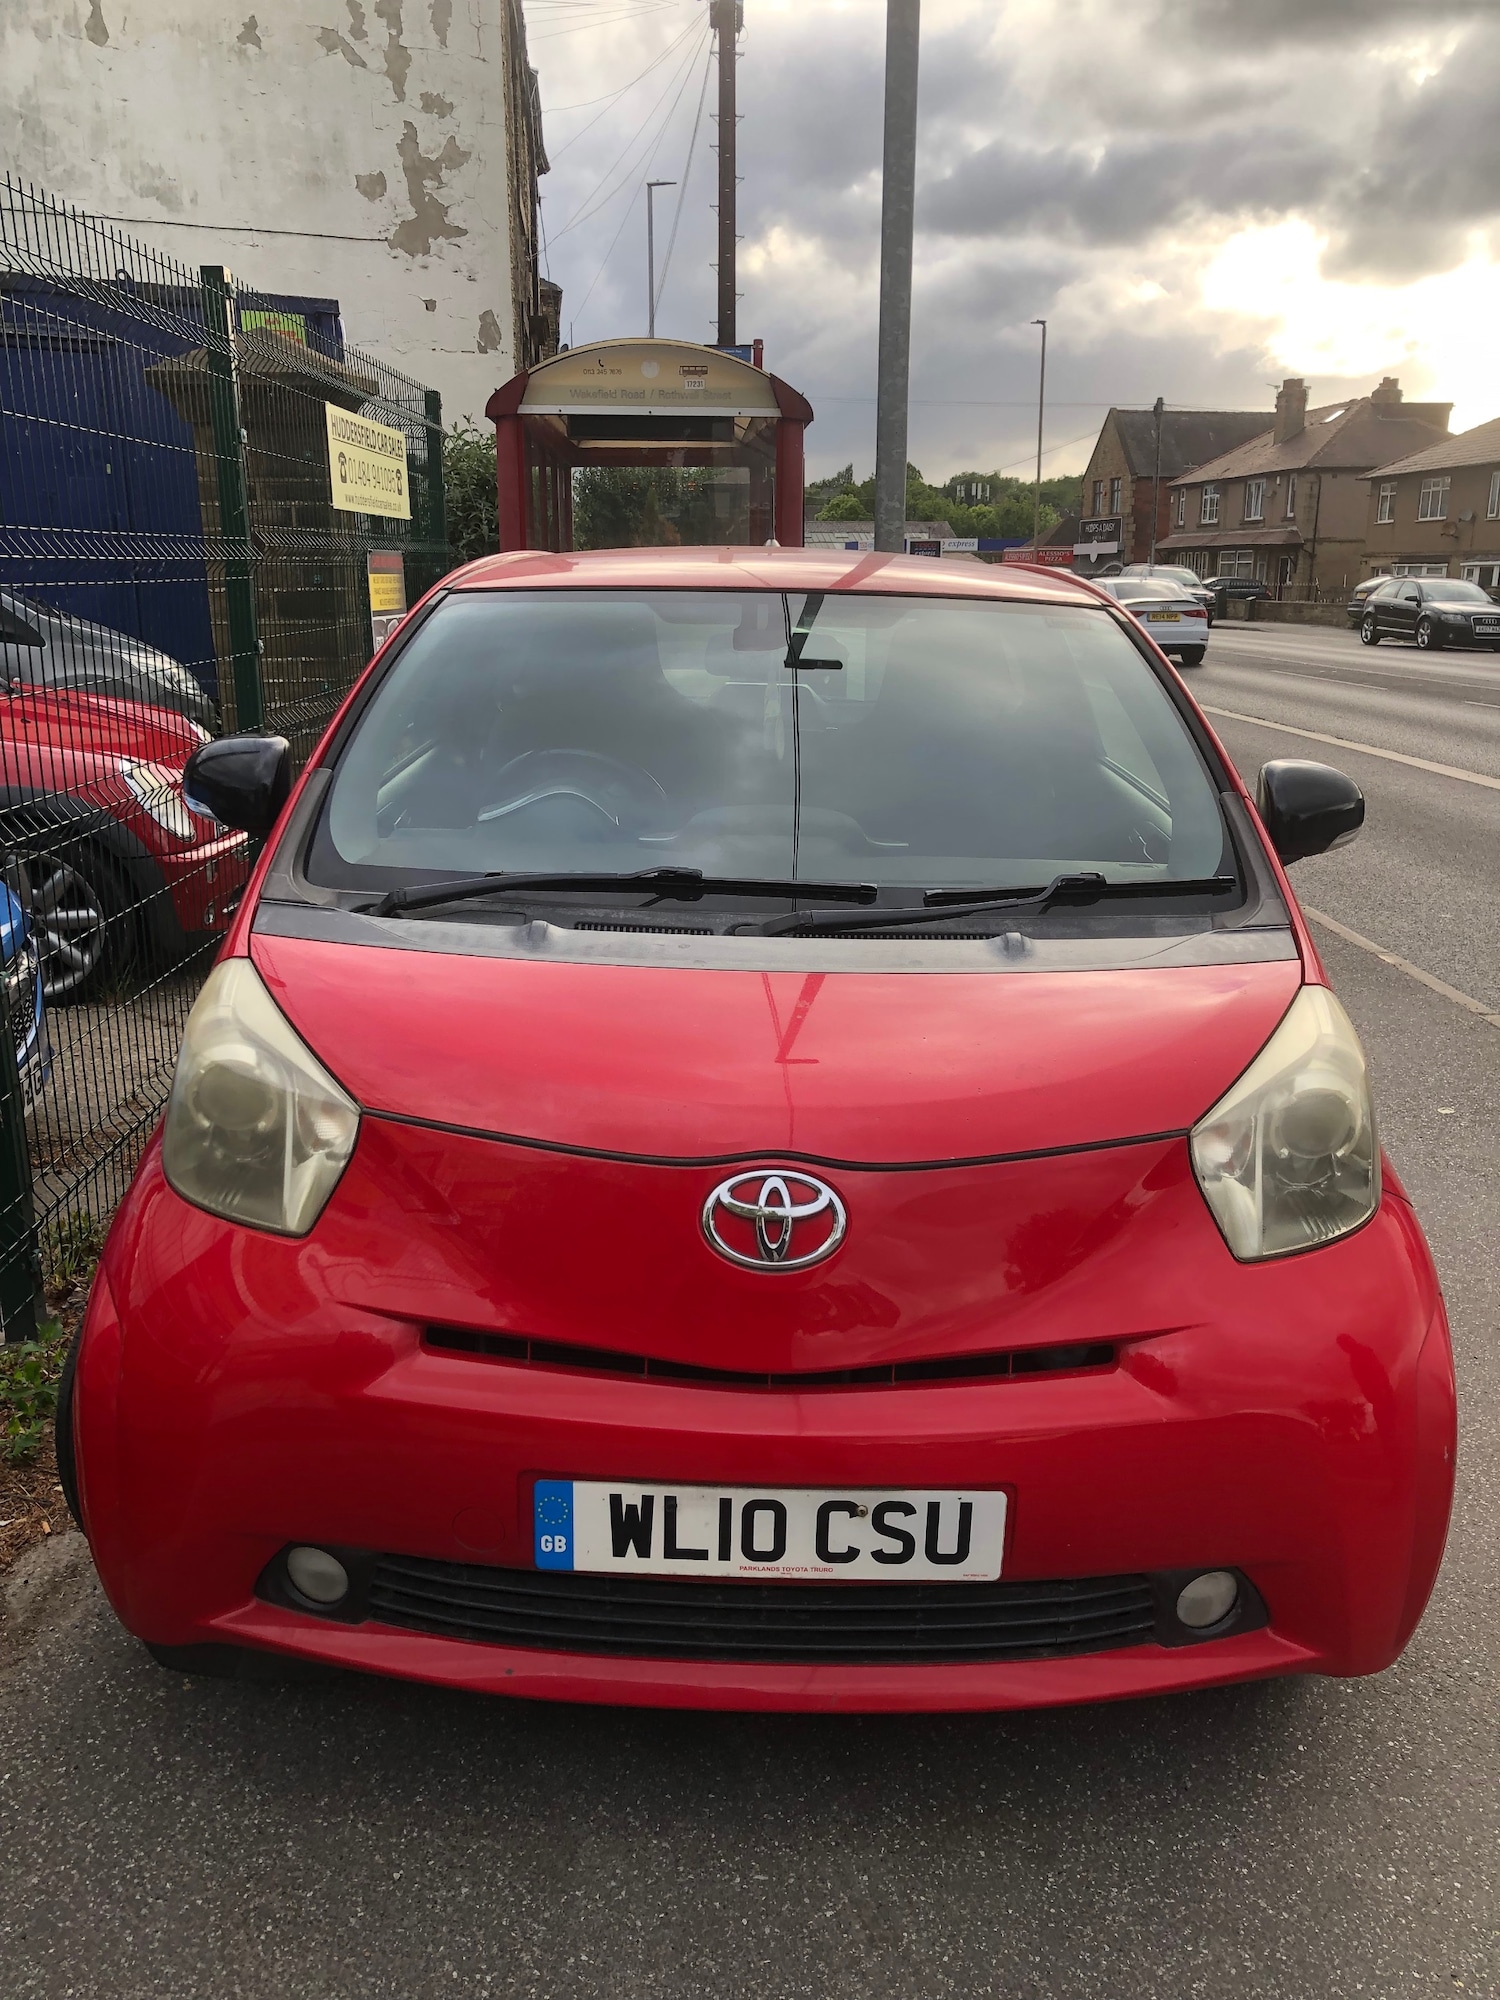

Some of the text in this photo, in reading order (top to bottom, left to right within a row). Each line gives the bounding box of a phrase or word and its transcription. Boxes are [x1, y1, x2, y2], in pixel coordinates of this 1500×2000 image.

[686, 380, 704, 388] 17231
[569, 388, 617, 399] Wakefield
[620, 389, 646, 400] Road
[649, 389, 655, 399] /
[703, 390, 732, 401] Street
[331, 413, 404, 459] HUDDERSFIELD CAR SALES
[348, 457, 371, 488] 01484
[947, 540, 975, 550] express
[609, 1493, 973, 1565] WL10 CSU
[540, 1535, 567, 1553] GB
